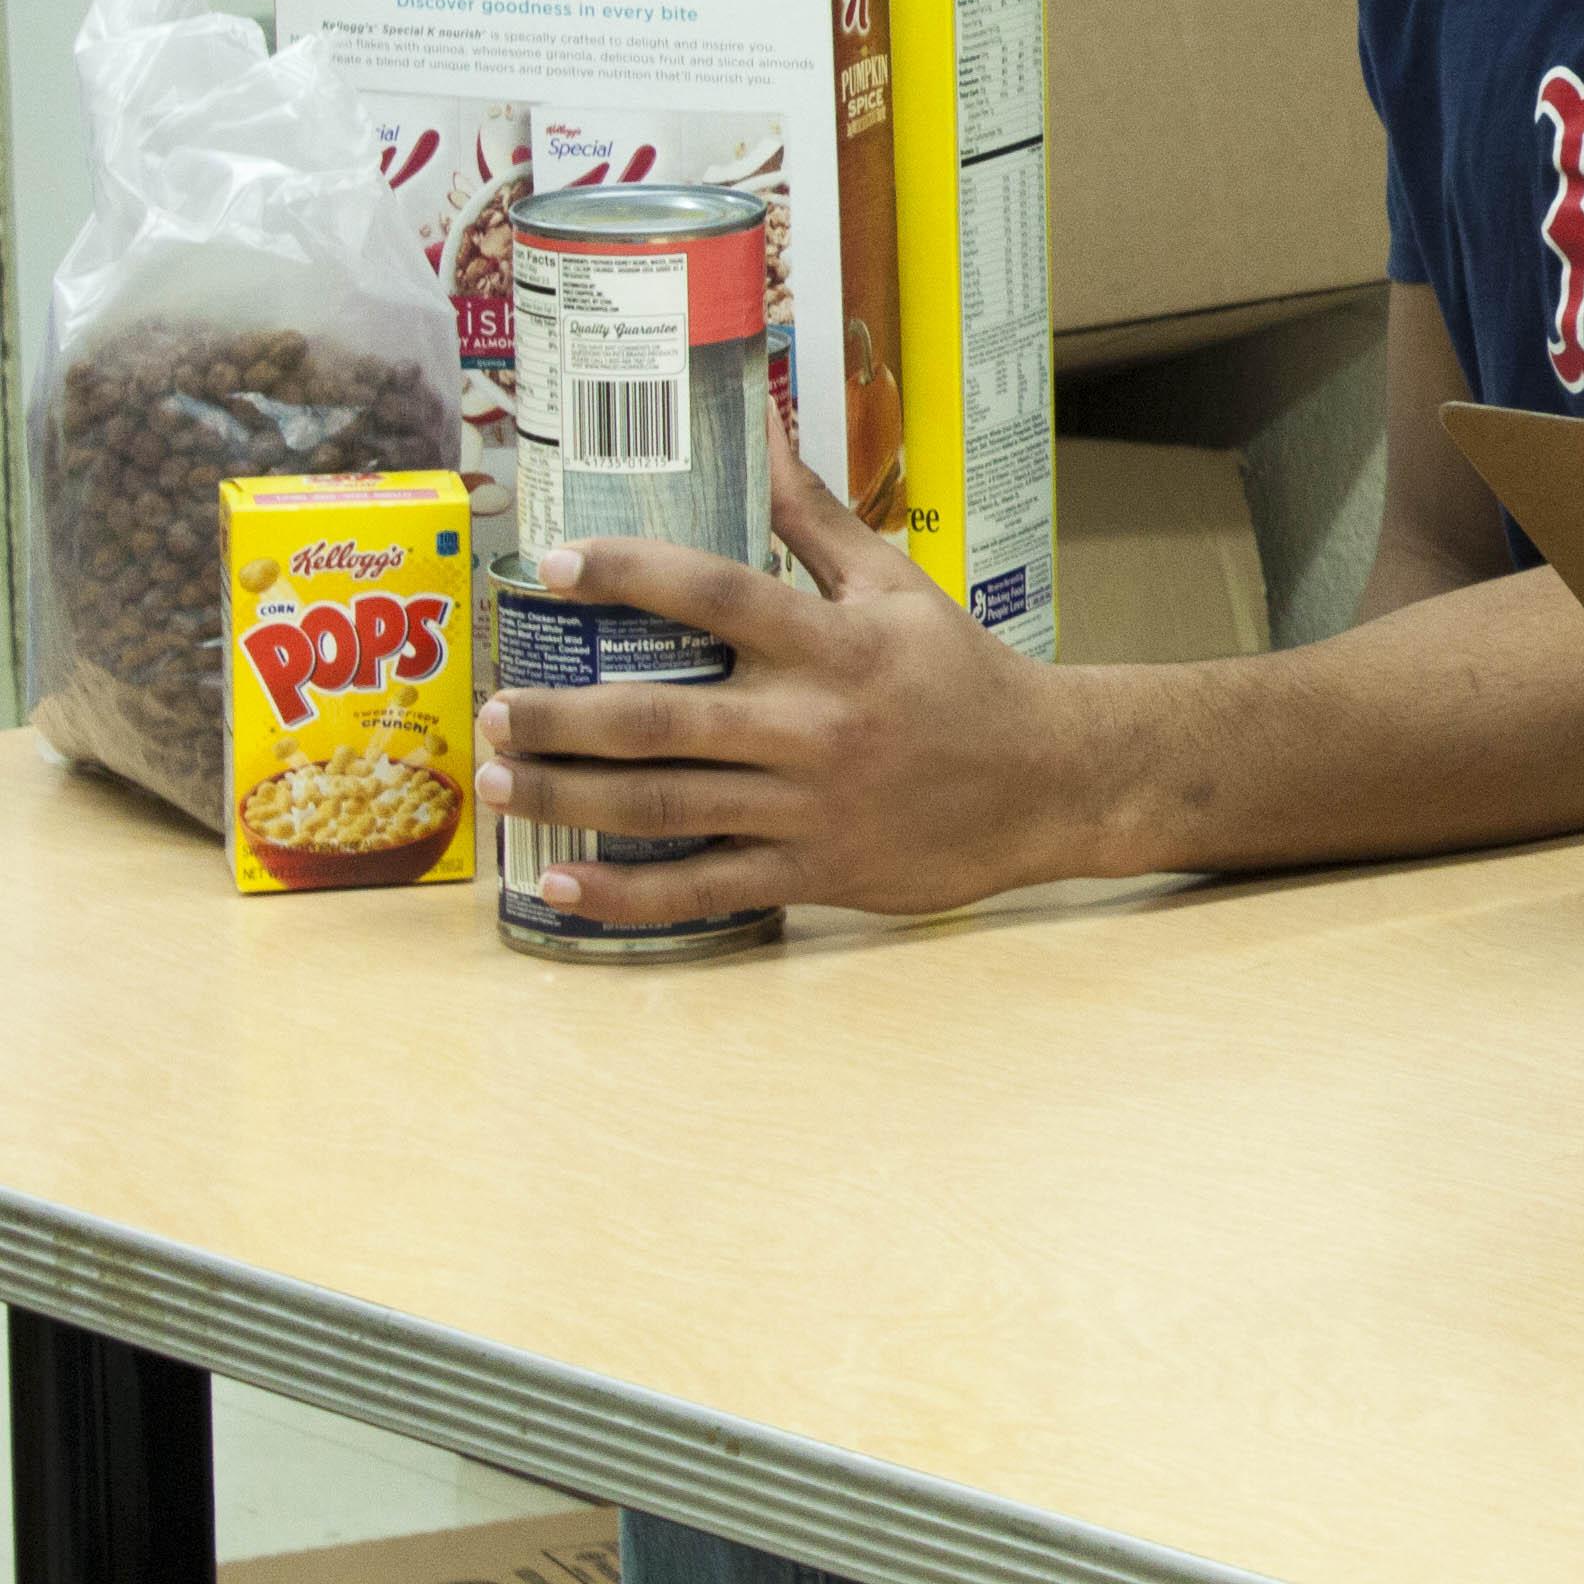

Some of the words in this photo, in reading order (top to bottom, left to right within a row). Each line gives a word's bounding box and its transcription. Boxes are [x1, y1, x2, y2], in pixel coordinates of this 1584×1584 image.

[481, 0, 572, 17] goodness
[579, 3, 596, 18] in
[602, 5, 654, 23] every
[661, 4, 698, 22] bite
[382, 24, 424, 39] Special
[427, 27, 438, 38] K
[489, 31, 500, 41] is
[503, 32, 556, 46] specially
[560, 33, 605, 46] crafted
[609, 36, 622, 47] to
[626, 37, 670, 52] delight
[673, 39, 698, 51] and
[702, 40, 745, 55] inspire
[356, 39, 390, 52] flakes
[395, 40, 420, 53] with
[471, 46, 542, 59] wholesome
[600, 51, 656, 65] delicious
[659, 53, 685, 66] fruit
[689, 55, 713, 67] and
[717, 56, 755, 68] sliced
[758, 58, 815, 71] almonds
[376, 55, 410, 68] blend
[413, 57, 426, 69] of
[430, 59, 471, 73] unique
[474, 61, 516, 74] flavors
[519, 63, 543, 75] and
[545, 65, 594, 79] positive
[598, 66, 651, 80] nutrition
[695, 71, 743, 84] nourish
[841, 53, 888, 104] PUMPKIN
[847, 87, 884, 118] SPICE
[548, 137, 614, 160] Special
[526, 249, 557, 267] Facts
[569, 319, 609, 339] Quality
[614, 322, 678, 339] Guarantee
[292, 541, 403, 579] Kellogg's
[260, 603, 296, 616] CORN
[600, 637, 676, 653] Nutrition
[242, 594, 452, 729] POPS
